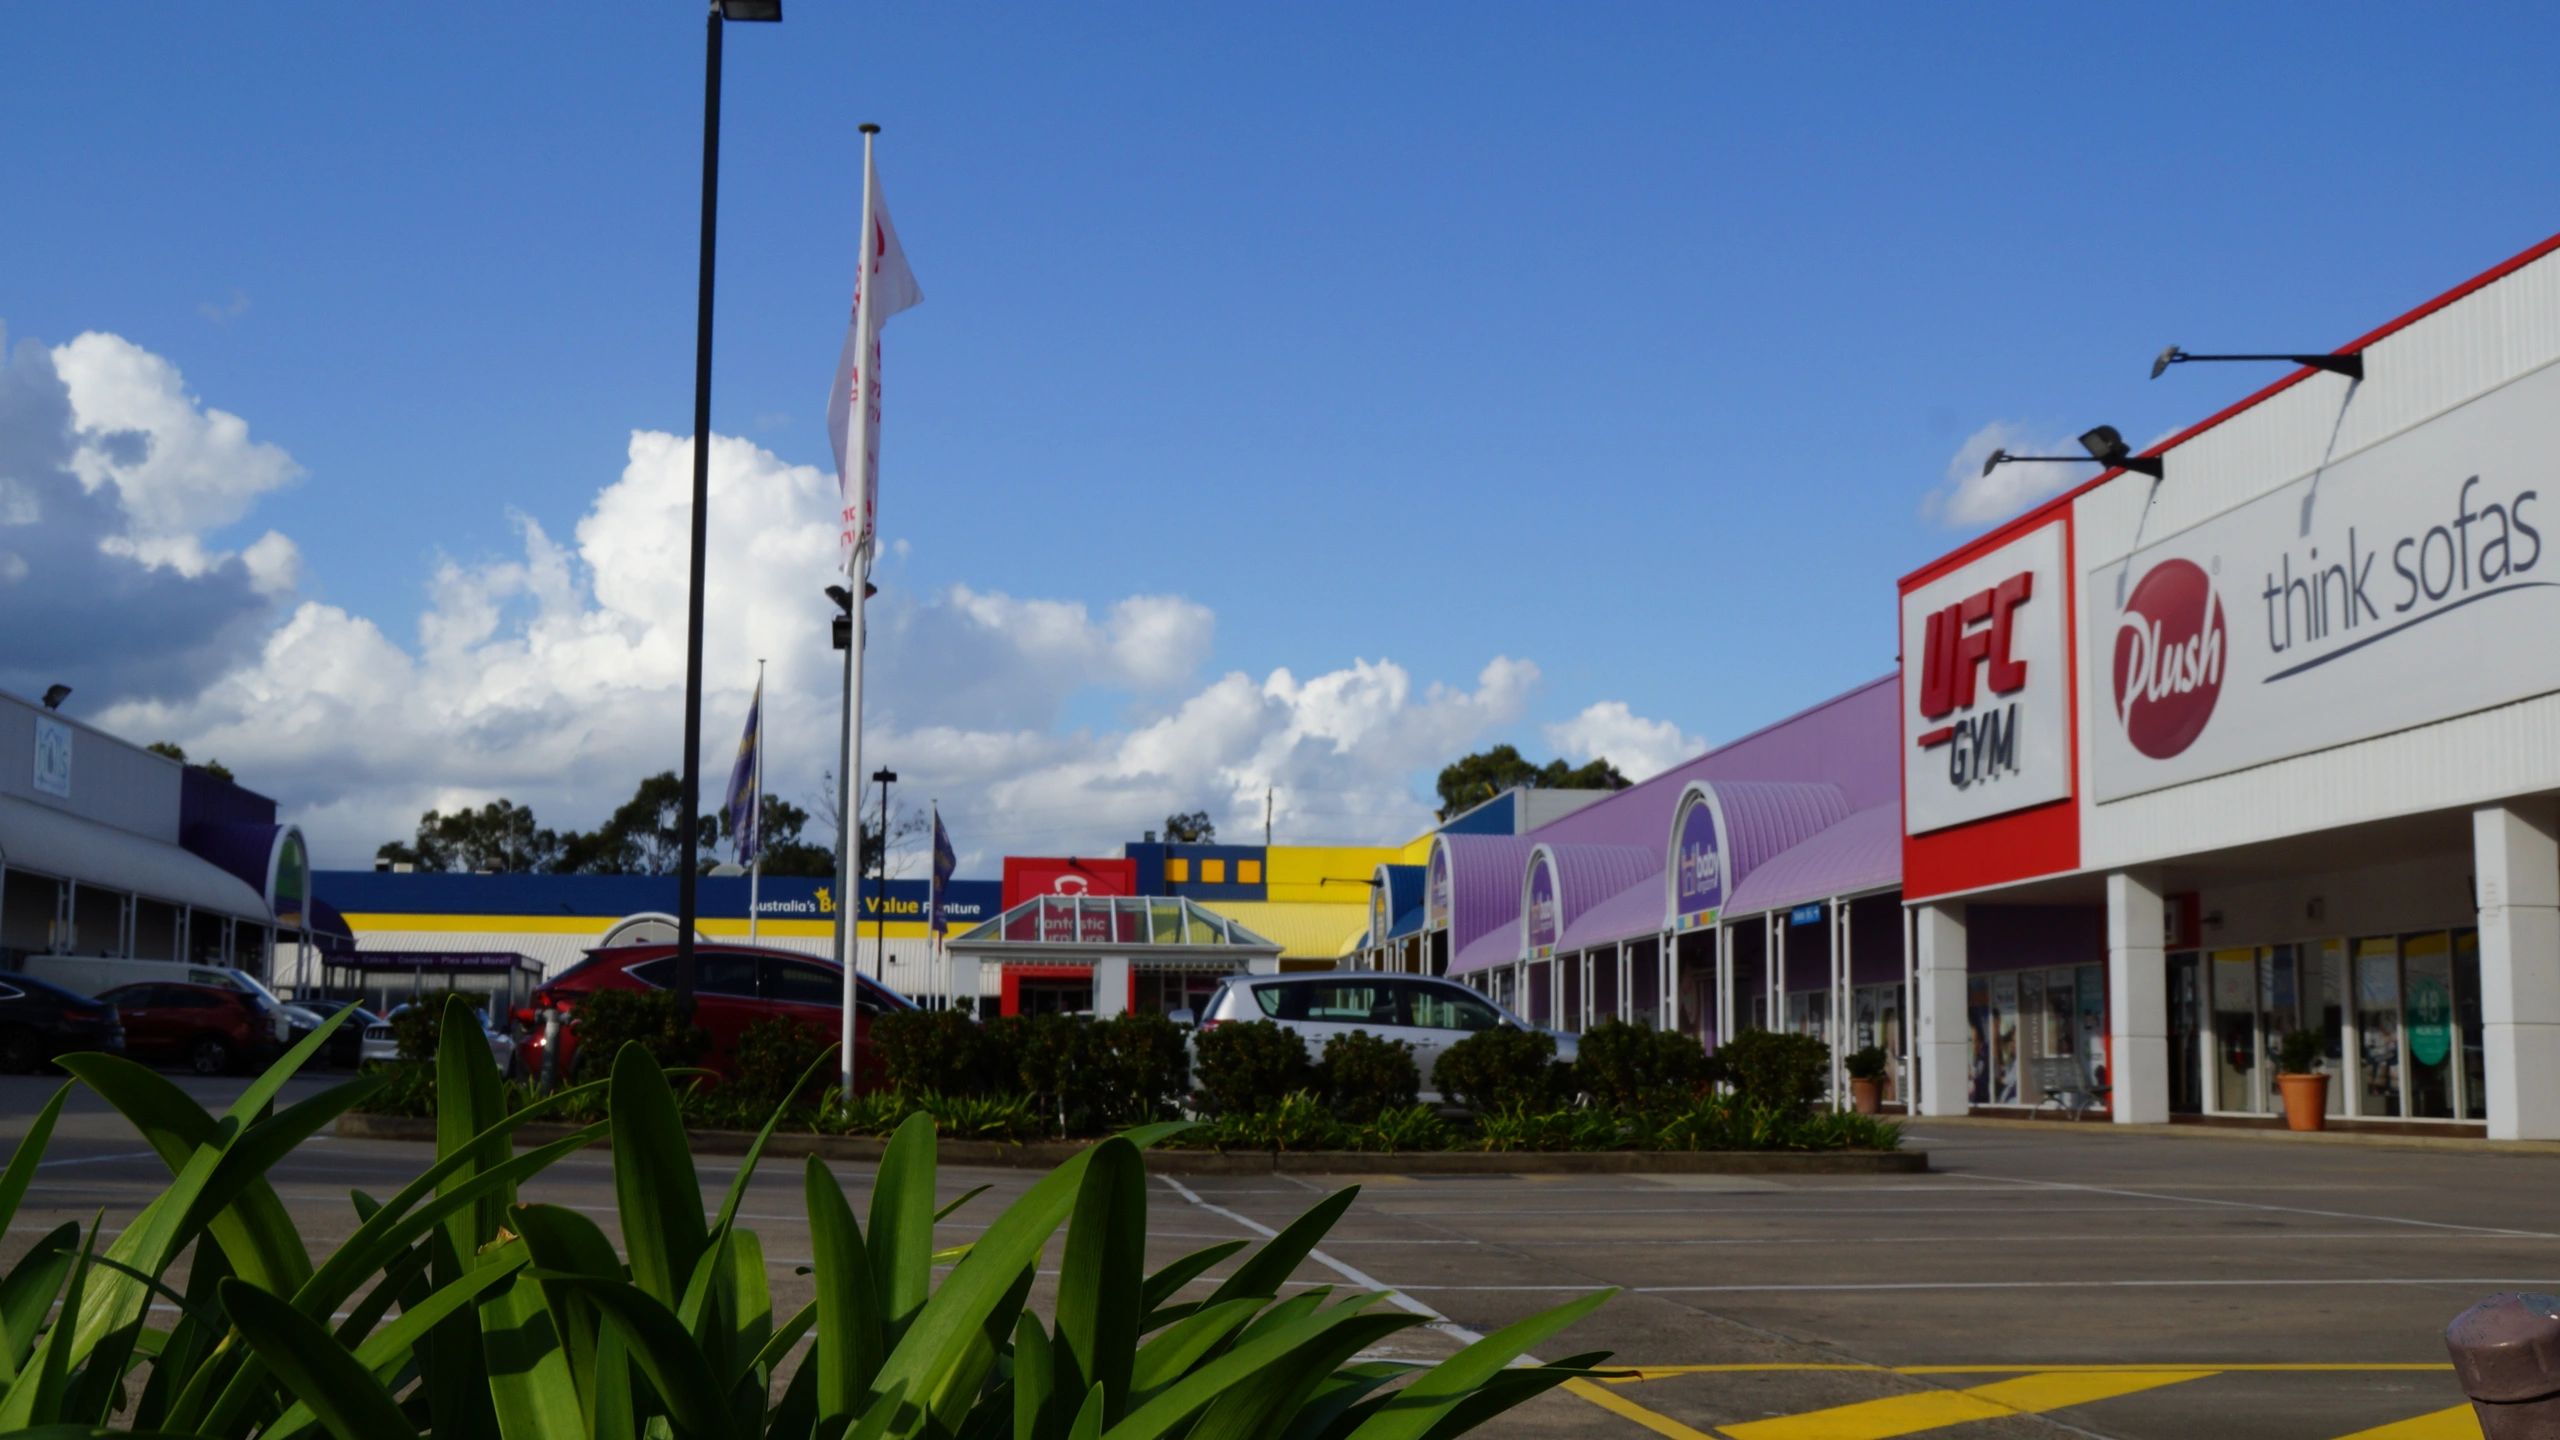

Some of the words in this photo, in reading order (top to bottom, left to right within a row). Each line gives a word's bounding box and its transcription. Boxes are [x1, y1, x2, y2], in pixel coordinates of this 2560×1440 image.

[2262, 527, 2379, 653] think
[2393, 474, 2541, 613] sofas
[1920, 570, 2034, 720] UFC
[2114, 575, 2222, 736] Plush
[1950, 703, 2018, 787] GYM
[865, 896, 919, 913] Value
[922, 901, 980, 914] Fniture
